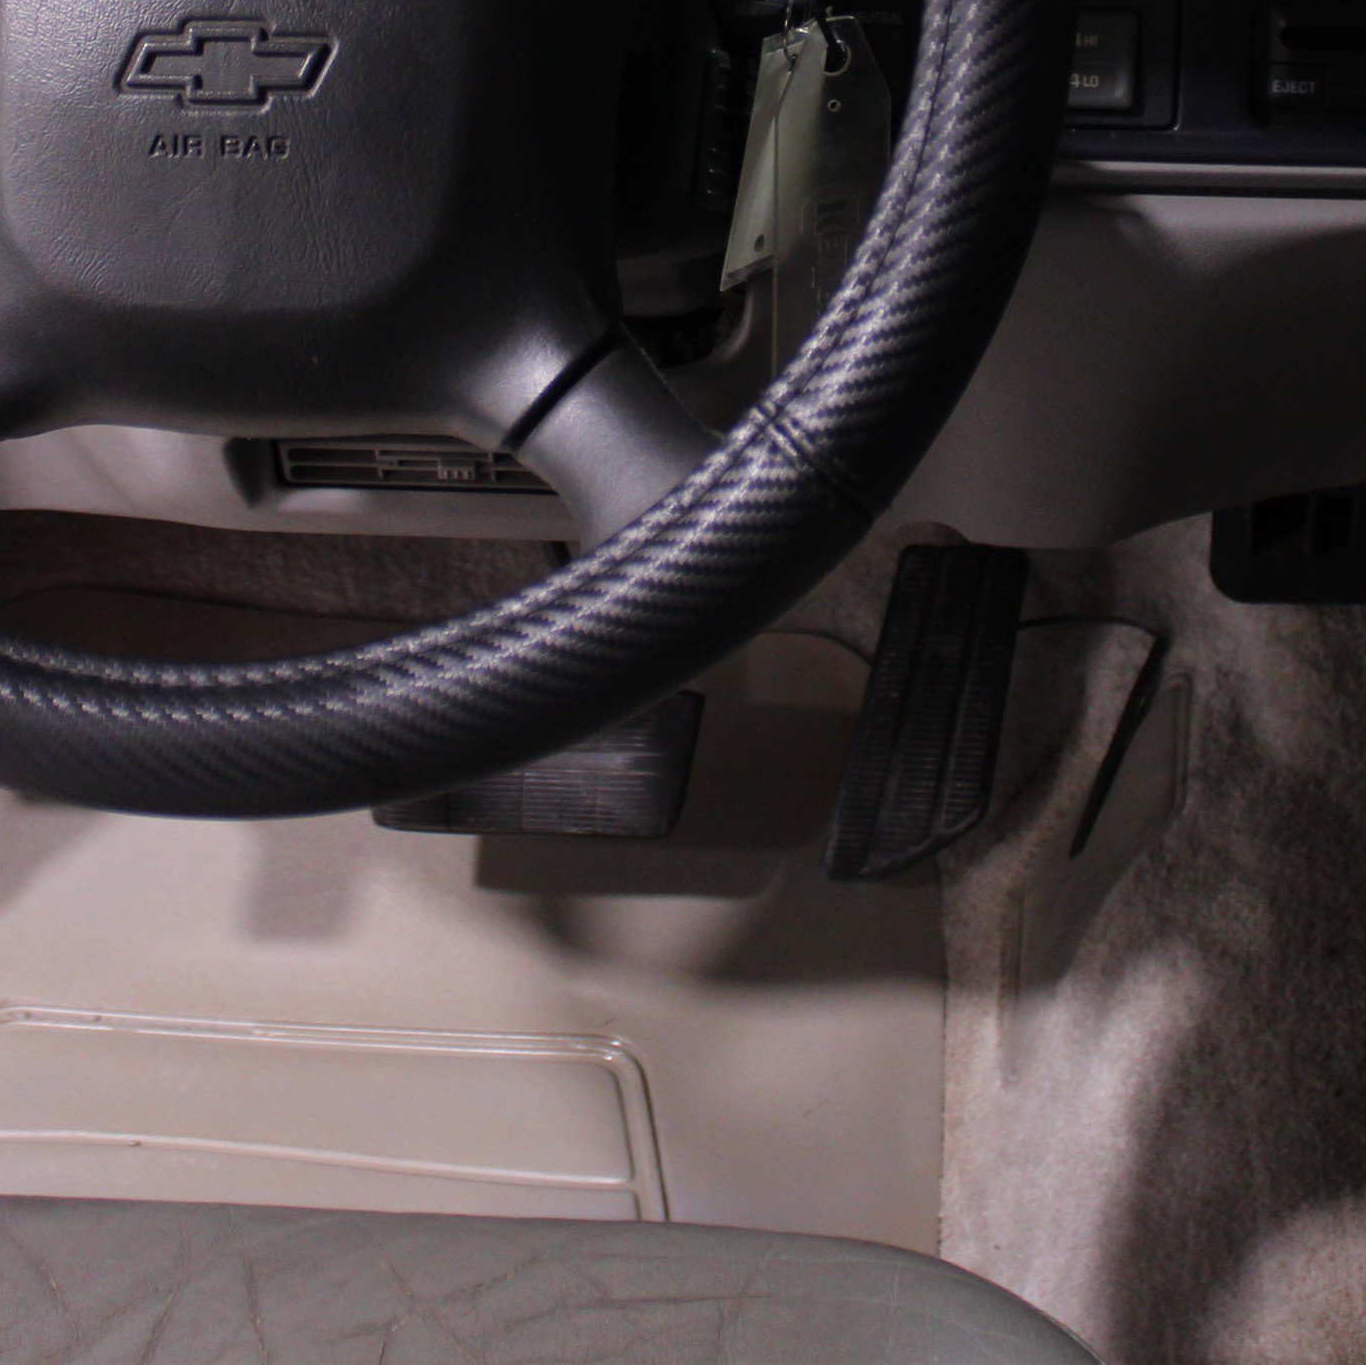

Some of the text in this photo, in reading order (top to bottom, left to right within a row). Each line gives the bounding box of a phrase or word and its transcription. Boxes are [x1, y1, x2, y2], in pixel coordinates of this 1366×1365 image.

[1082, 74, 1100, 88] LO
[1273, 80, 1316, 94] EJECT
[149, 133, 292, 160] AIR BAG
